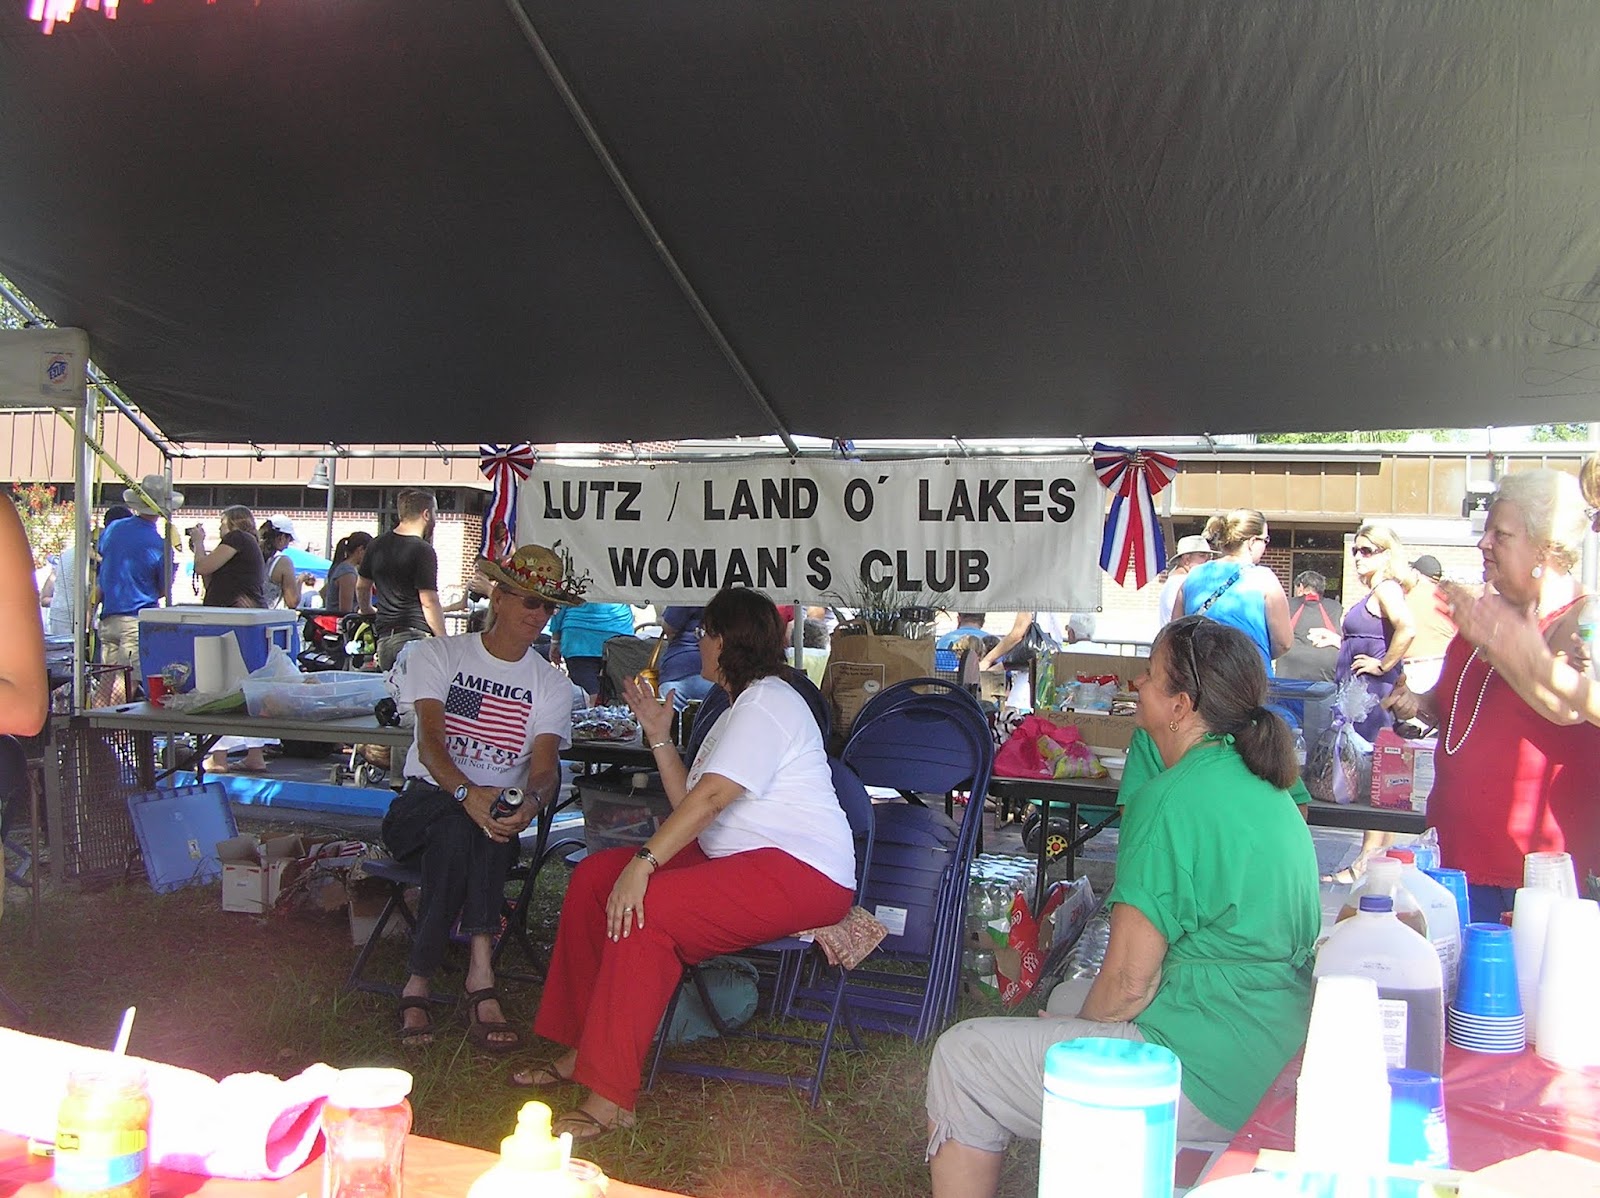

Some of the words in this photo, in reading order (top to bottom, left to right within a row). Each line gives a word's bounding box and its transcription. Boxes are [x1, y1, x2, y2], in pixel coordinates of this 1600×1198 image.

[542, 480, 642, 521] LUTZ
[666, 481, 680, 521] /
[703, 477, 819, 521] LAND
[918, 478, 1076, 522] LAKES
[607, 546, 832, 590] WOMAN'S
[860, 549, 990, 592] CLUB
[452, 671, 533, 704] AMERICA
[469, 759, 484, 769] Not
[1373, 744, 1383, 773] PACK
[1371, 775, 1381, 806] VALUE
